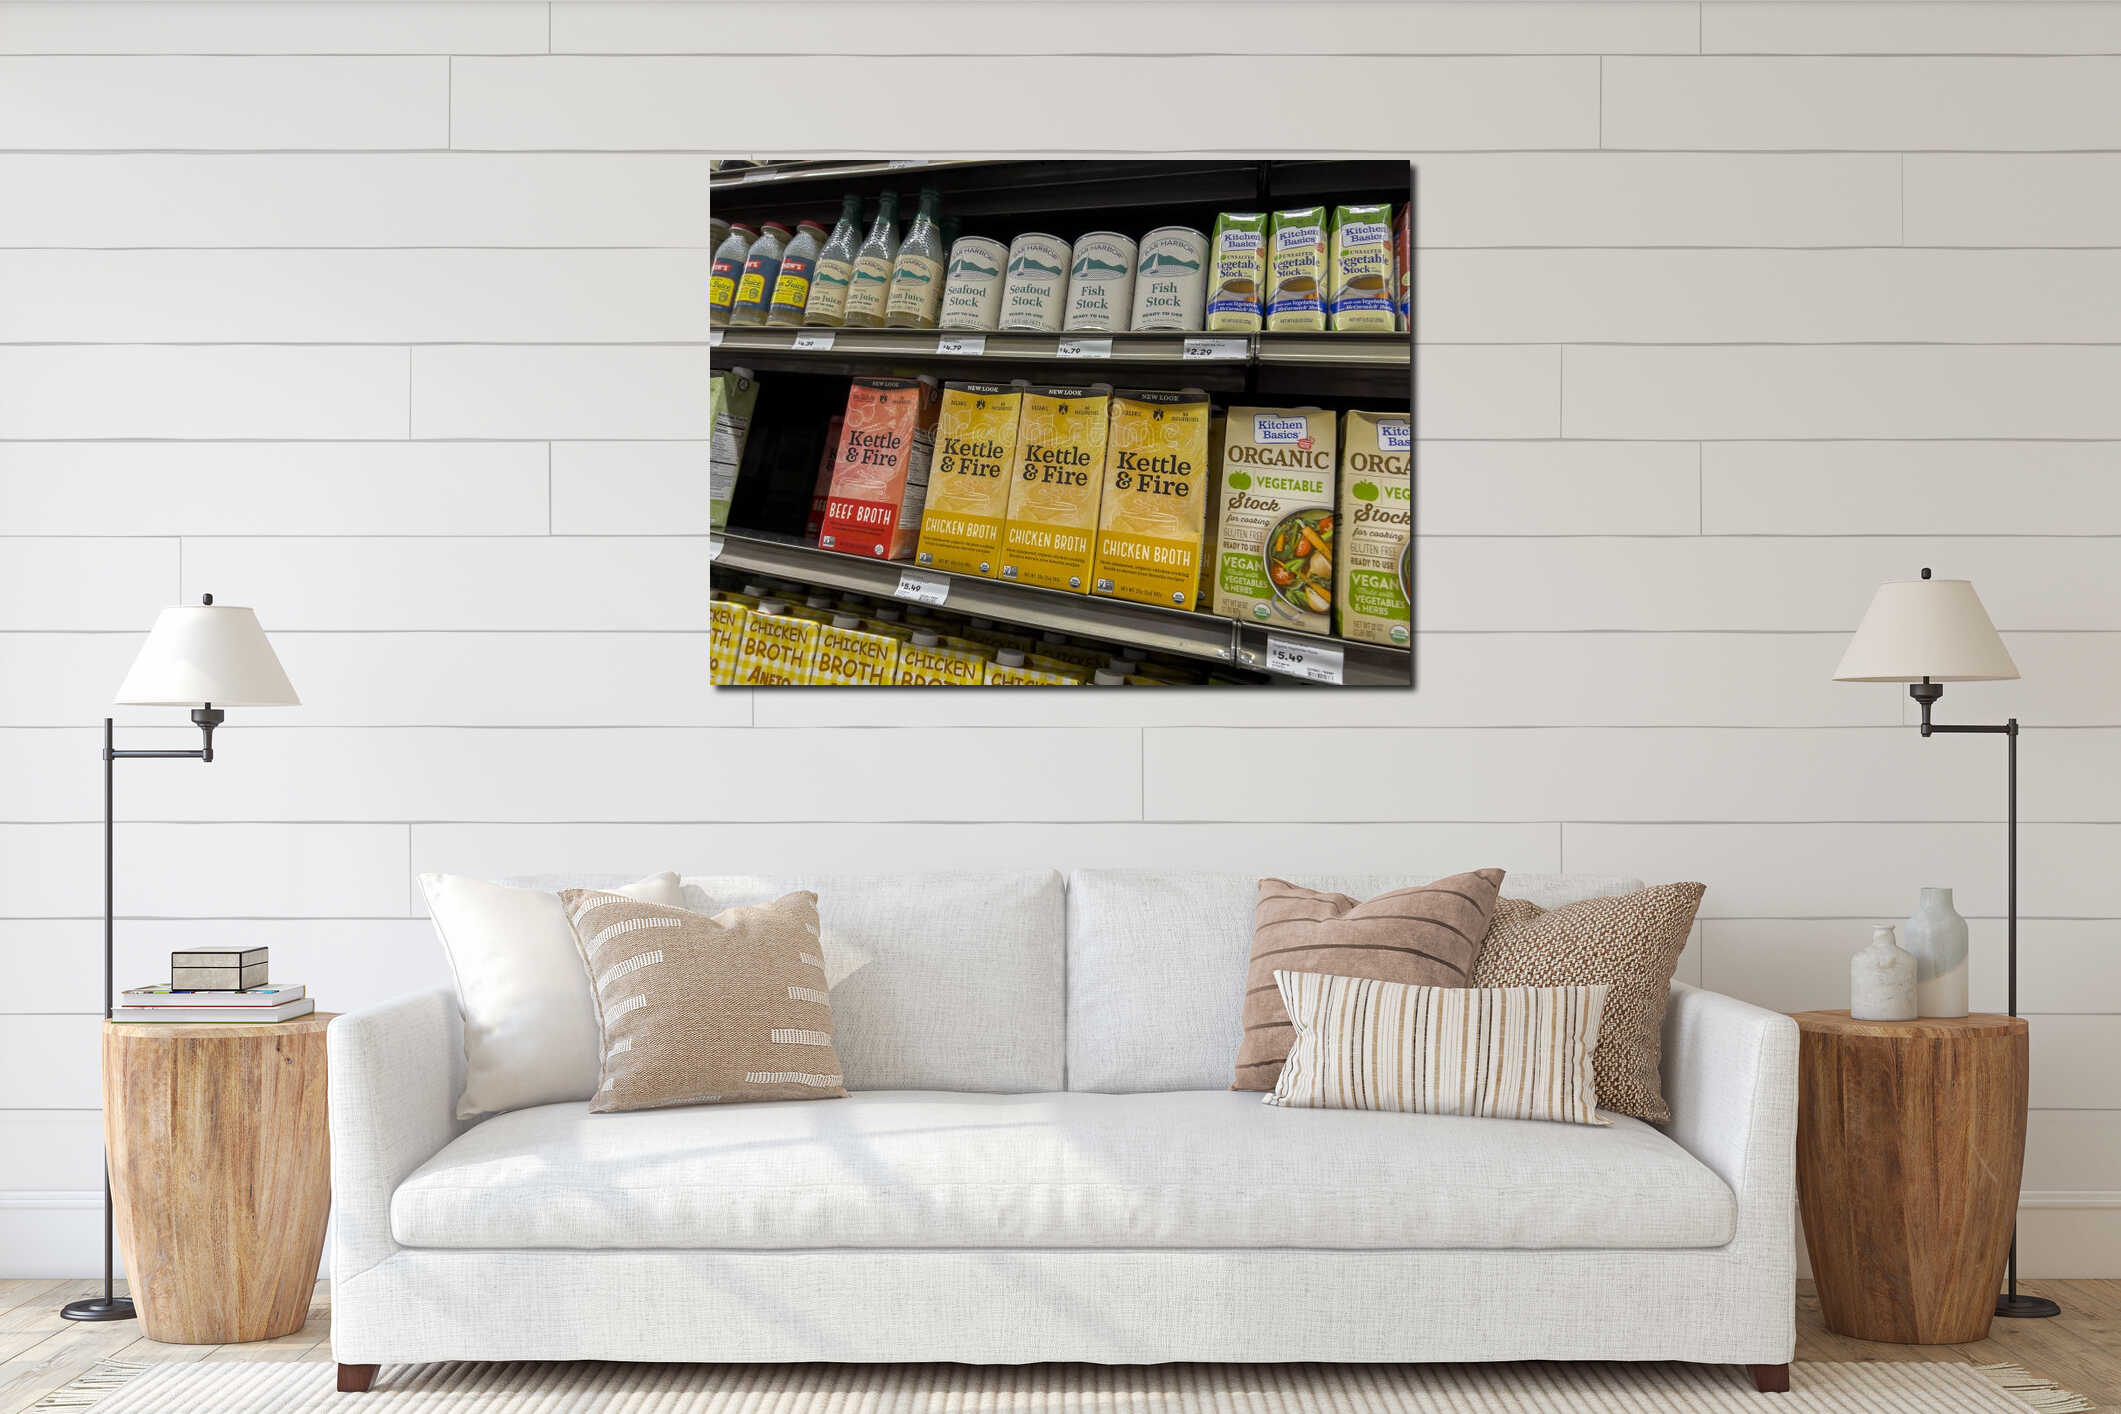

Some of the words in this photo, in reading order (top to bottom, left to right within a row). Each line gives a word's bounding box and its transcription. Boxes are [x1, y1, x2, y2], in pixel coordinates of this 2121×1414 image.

[1224, 232, 1261, 241] Kitchen
[1280, 229, 1318, 241] Kitchen
[1345, 226, 1386, 236] Kitchen
[1228, 240, 1257, 248] Basics
[1284, 237, 1316, 247] Basics
[1351, 234, 1384, 243] Basics
[1160, 239, 1194, 254] HARBOR
[1273, 255, 1320, 271] Vegetable
[1338, 253, 1389, 267] Vegetable
[1219, 269, 1243, 278] Stock
[1276, 267, 1301, 277] Stock
[1343, 265, 1370, 276] Stock
[947, 283, 986, 298] Seafood
[1009, 282, 1051, 297] Seafood
[1081, 285, 1105, 297] Fish
[1152, 281, 1177, 294] Fish
[949, 295, 979, 308] Stock
[1011, 294, 1044, 308] Stock
[1075, 298, 1108, 310] Stock
[1146, 295, 1181, 308] Stock
[1186, 348, 1212, 356] $2.29
[1063, 389, 1083, 397] LOOK
[1159, 394, 1178, 402] LOOK
[1258, 420, 1303, 430] Kitchen
[848, 430, 901, 449] Kettle
[1263, 430, 1299, 440] Basics
[942, 437, 1004, 459] Kettle
[846, 447, 859, 463] &
[861, 450, 898, 467] Fire
[1024, 444, 1091, 467] Kettle
[1228, 445, 1330, 470] ORGANIC
[940, 456, 954, 474] &
[957, 458, 1001, 478] Fire
[1117, 451, 1192, 477] Kettle
[1022, 463, 1038, 481] &
[1041, 465, 1088, 487] Fire
[1115, 471, 1133, 490] &
[1136, 473, 1190, 497] Fire
[1256, 476, 1323, 493] VEGETABLE
[1227, 491, 1281, 512] Stock
[829, 502, 855, 519] BEEF
[856, 506, 892, 526] BROTH
[1225, 514, 1239, 523] for
[1240, 516, 1271, 527] cooking
[925, 517, 964, 538] CHICKEN
[966, 522, 998, 542] BROTH
[1224, 527, 1248, 538] GLUTEN
[1352, 527, 1367, 538] for
[1369, 530, 1403, 544] cooking
[1009, 527, 1050, 549] CHICKEN
[1054, 533, 1088, 553] BROTH
[1223, 541, 1240, 550] READY
[1250, 544, 1260, 552] USE
[1102, 538, 1151, 562] CHICKEN
[1153, 544, 1192, 567] BROTH
[1351, 542, 1380, 555] GLUTEN
[1223, 555, 1264, 572] VEGAN
[1351, 557, 1371, 567] READY
[1372, 559, 1381, 568] TO
[1382, 561, 1394, 570] USE
[901, 582, 921, 593] $5.49
[1225, 575, 1267, 589] VEGETABLES
[1351, 573, 1400, 591] VEGAN
[1354, 593, 1406, 609] VEGETABLES
[750, 619, 809, 645] CHICKEN
[744, 637, 804, 668] BROTH
[824, 634, 888, 661] CHICKEN
[1272, 649, 1303, 663] $5.49
[818, 652, 885, 685] BROTH
[905, 651, 976, 681] CHICKEN
